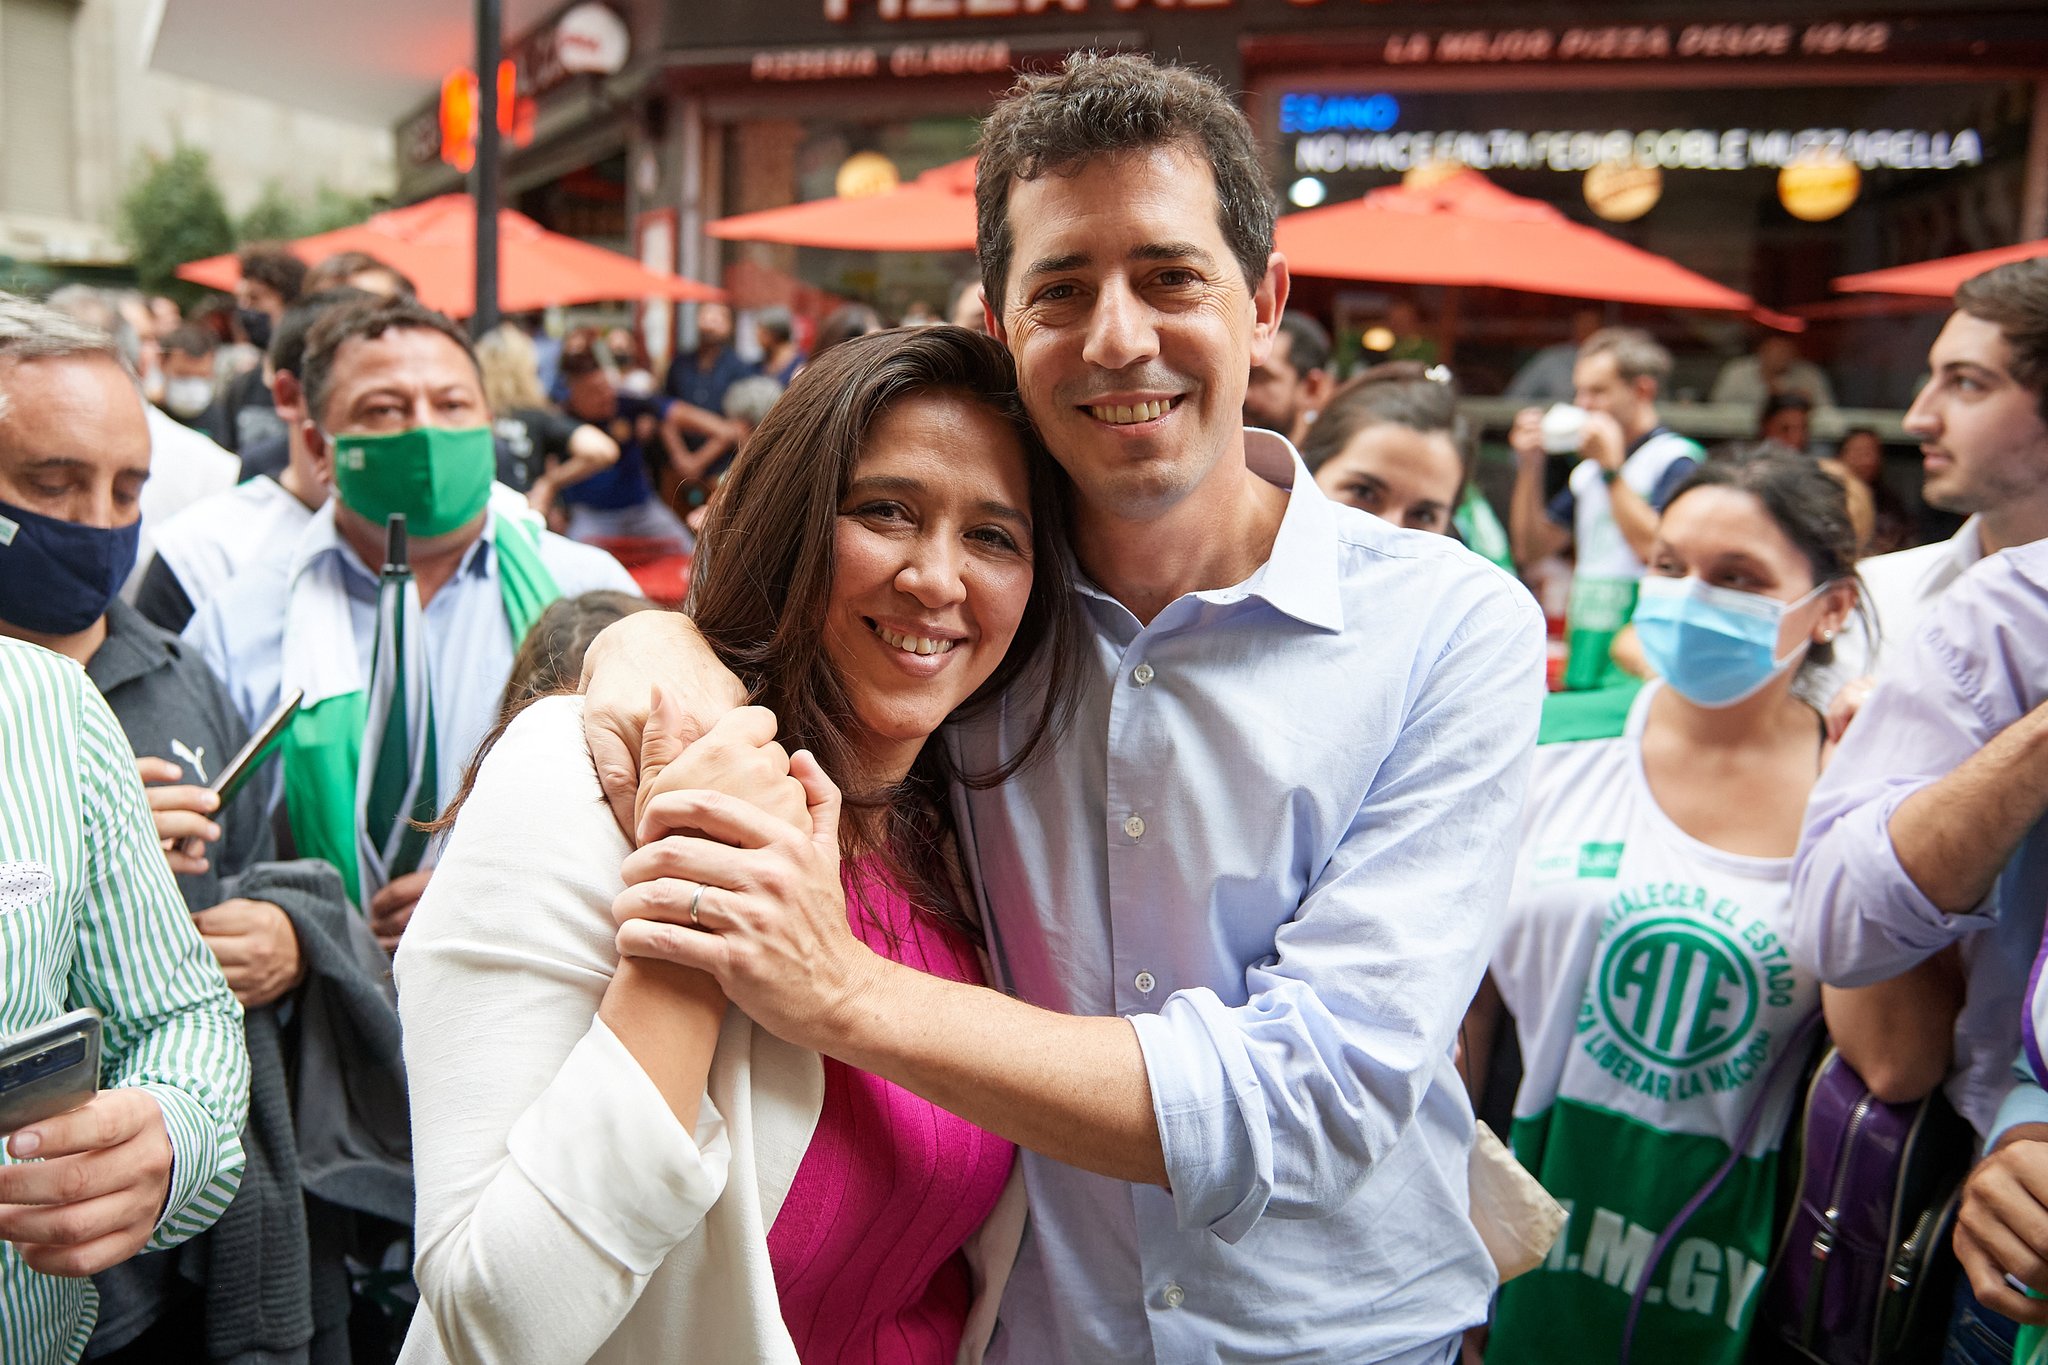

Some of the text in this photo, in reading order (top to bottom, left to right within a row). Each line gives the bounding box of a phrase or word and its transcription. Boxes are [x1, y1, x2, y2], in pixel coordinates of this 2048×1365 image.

[1436, 29, 1551, 61] MEJOR
[1558, 26, 1670, 57] PIZZA
[1677, 24, 1793, 55] DESDE
[1614, 931, 1741, 1055] ATE
[1712, 898, 1741, 927] EL
[1741, 919, 1795, 1007] ESTADO
[1584, 1032, 1672, 1101] LIBERAR
[1677, 1071, 1703, 1099] LA
